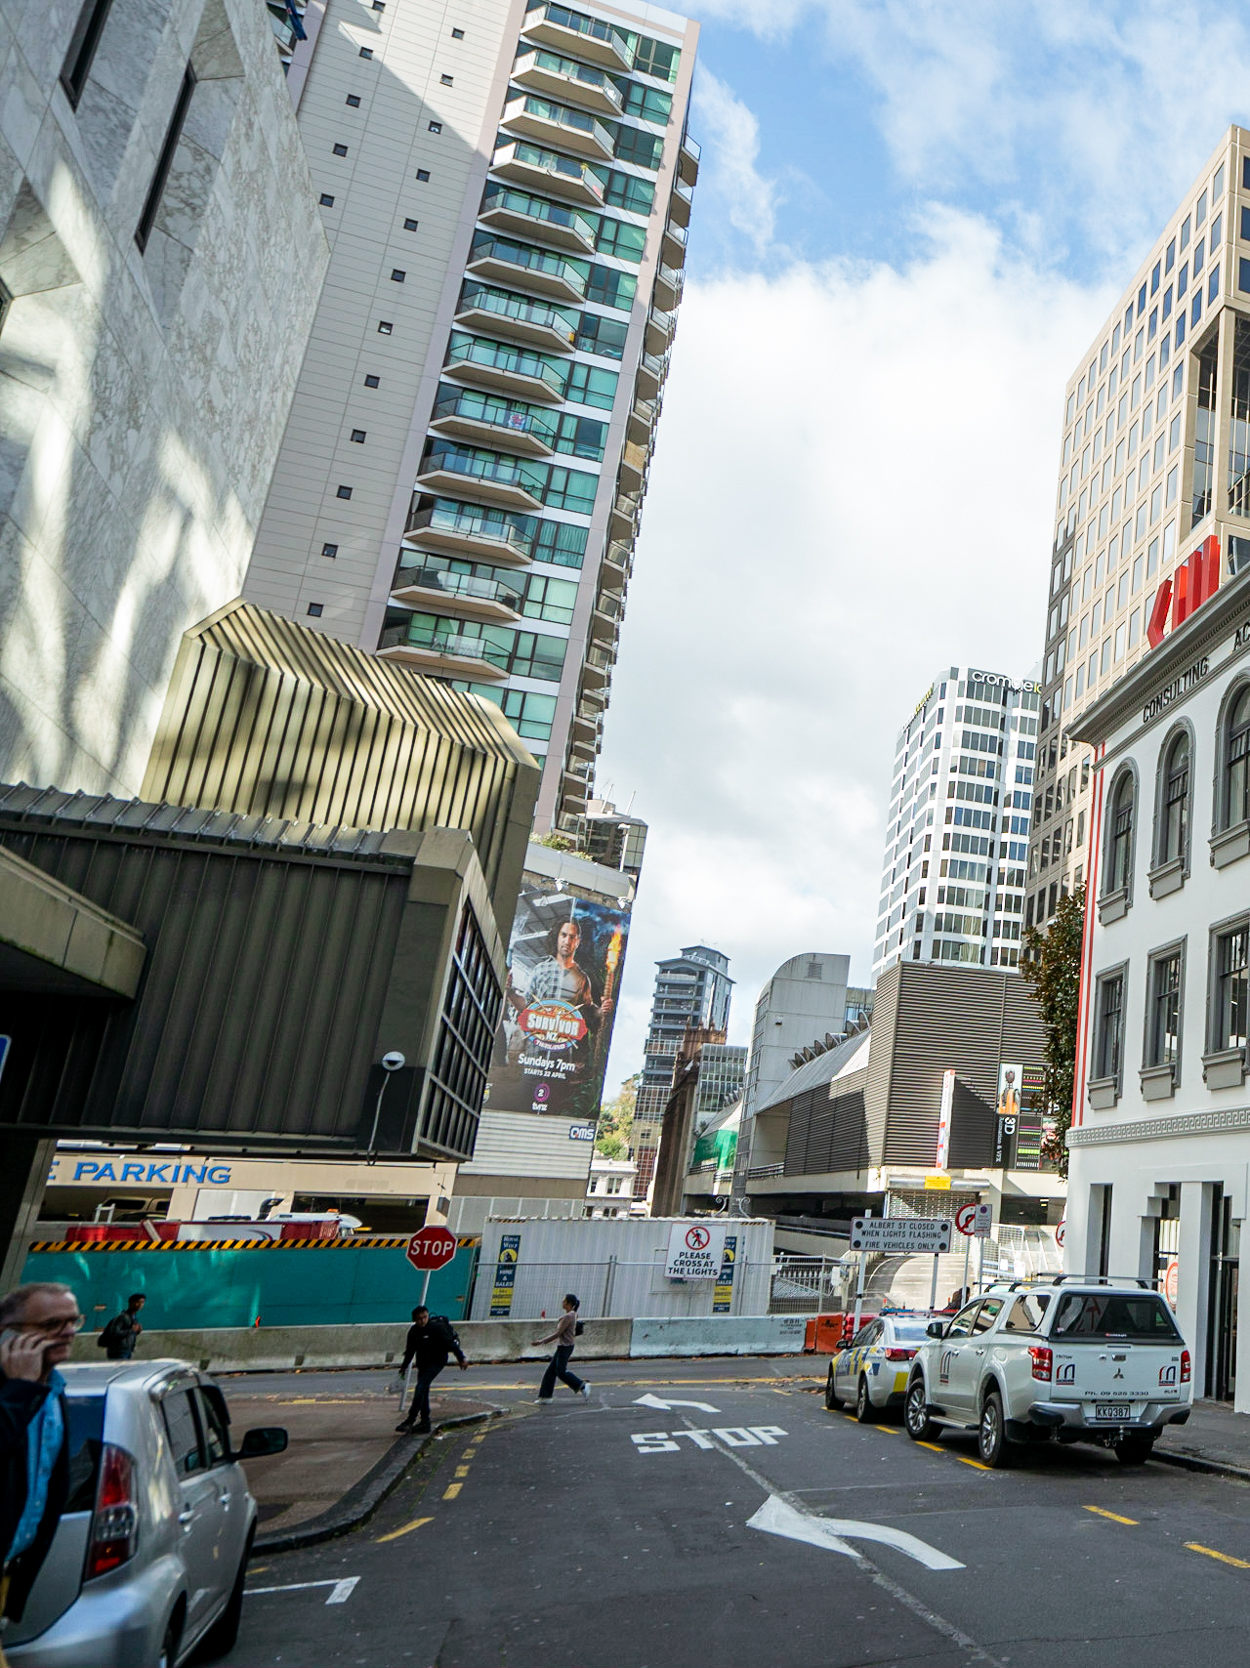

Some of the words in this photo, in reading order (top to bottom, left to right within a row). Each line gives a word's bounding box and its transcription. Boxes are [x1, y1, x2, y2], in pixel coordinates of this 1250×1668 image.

[1143, 657, 1209, 723] CONSULTING
[527, 1013, 579, 1036] SURVIVOR
[546, 1031, 557, 1040] NZ
[518, 1053, 554, 1071] Sundays
[556, 1058, 576, 1073] 7pm
[524, 1068, 543, 1076] STARTS
[543, 1070, 551, 1078] 22
[551, 1071, 567, 1080] APRIL
[537, 1089, 545, 1097] 2
[1005, 1117, 1016, 1135] 3D
[73, 1161, 231, 1184] PARKING
[869, 1221, 895, 1229] ALBERT
[909, 1222, 935, 1230] CLOSED
[908, 1231, 941, 1239] FLASHING
[410, 1239, 453, 1256] STOP
[883, 1241, 915, 1250] VEHICLES
[917, 1242, 935, 1250] ONLY
[679, 1251, 711, 1260] PLEASE
[703, 1260, 715, 1268] AT
[668, 1267, 685, 1275] THE
[686, 1268, 718, 1276] LIGHTS
[1097, 1407, 1129, 1418] KKQ387
[630, 1426, 789, 1453] STOP
